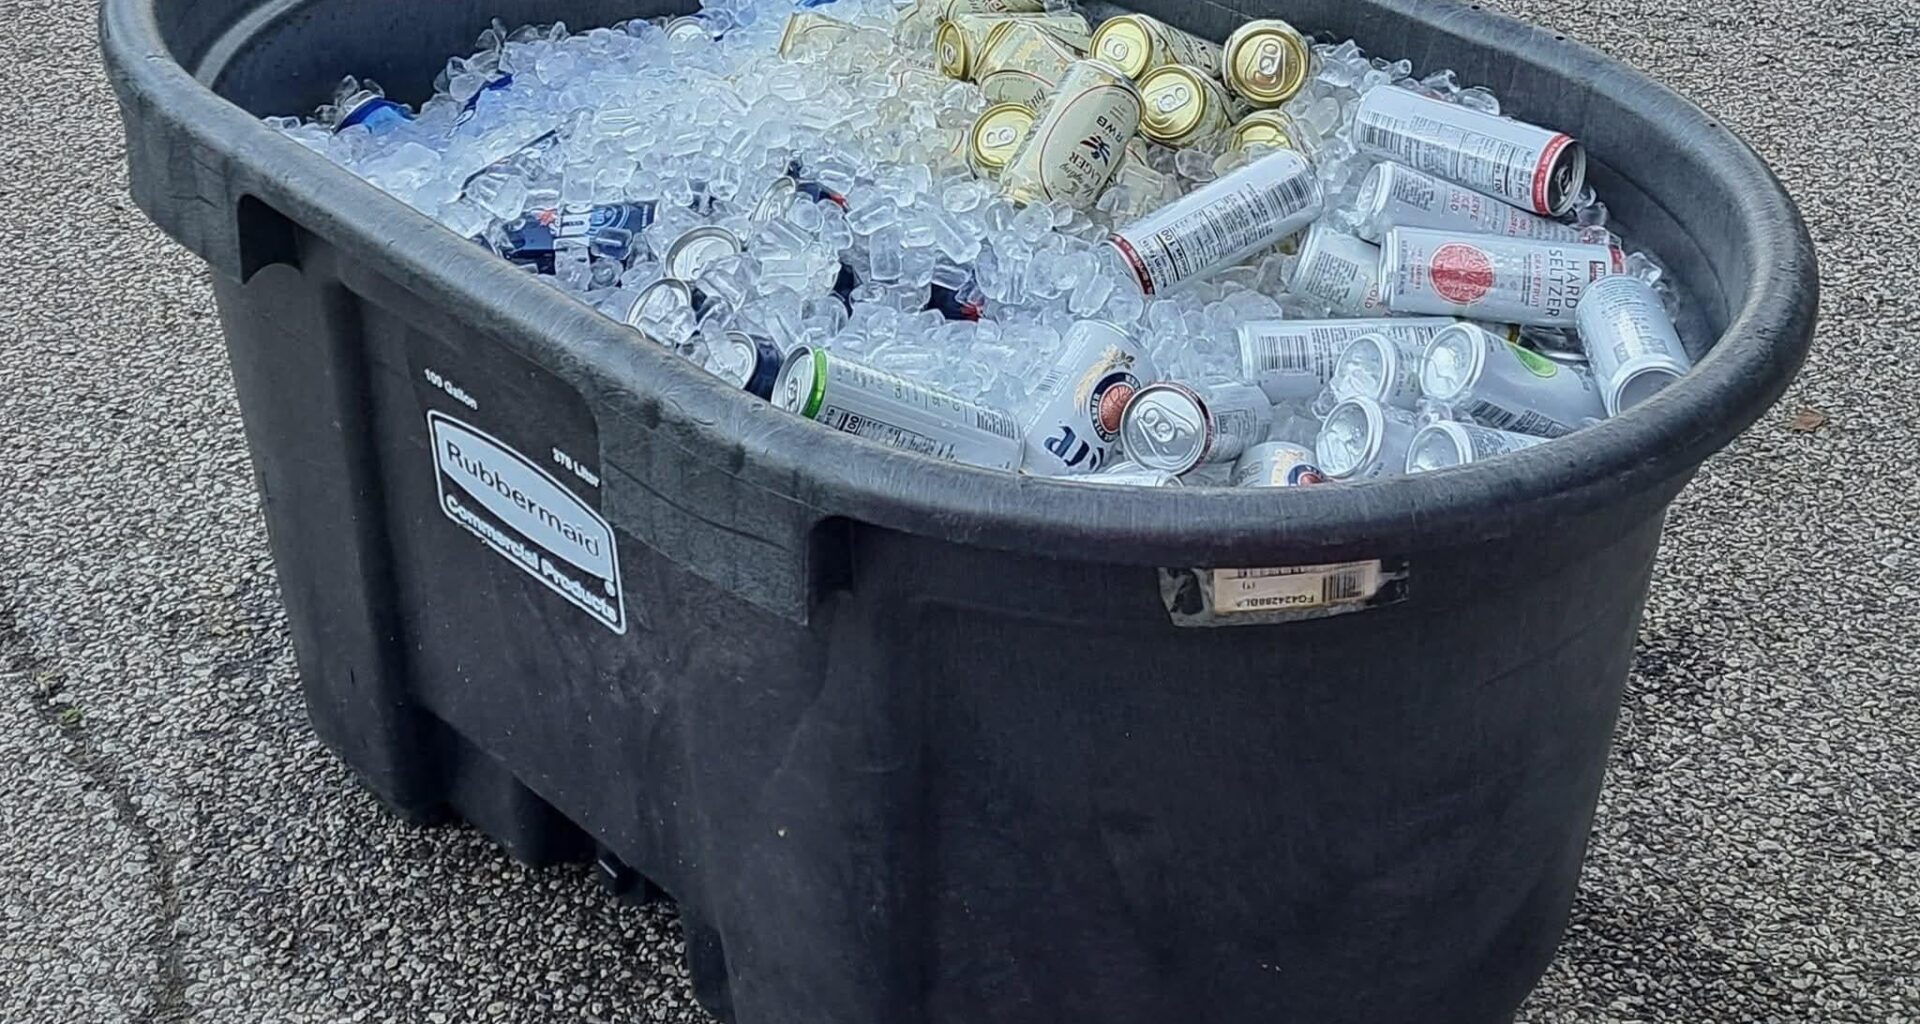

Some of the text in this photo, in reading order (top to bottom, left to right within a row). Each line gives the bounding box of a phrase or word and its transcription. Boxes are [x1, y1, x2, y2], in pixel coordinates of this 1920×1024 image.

[1096, 115, 1123, 142] RWB
[1068, 152, 1101, 185] LAGER
[1161, 229, 1175, 246] 100
[1531, 254, 1541, 307] GRAPEFRUIT
[1545, 250, 1562, 316] SELTZER
[1565, 260, 1580, 308] HARD
[424, 368, 478, 410] 100 Gallon
[446, 440, 600, 557] Rubbermaid
[446, 495, 618, 623] Commercial Products
